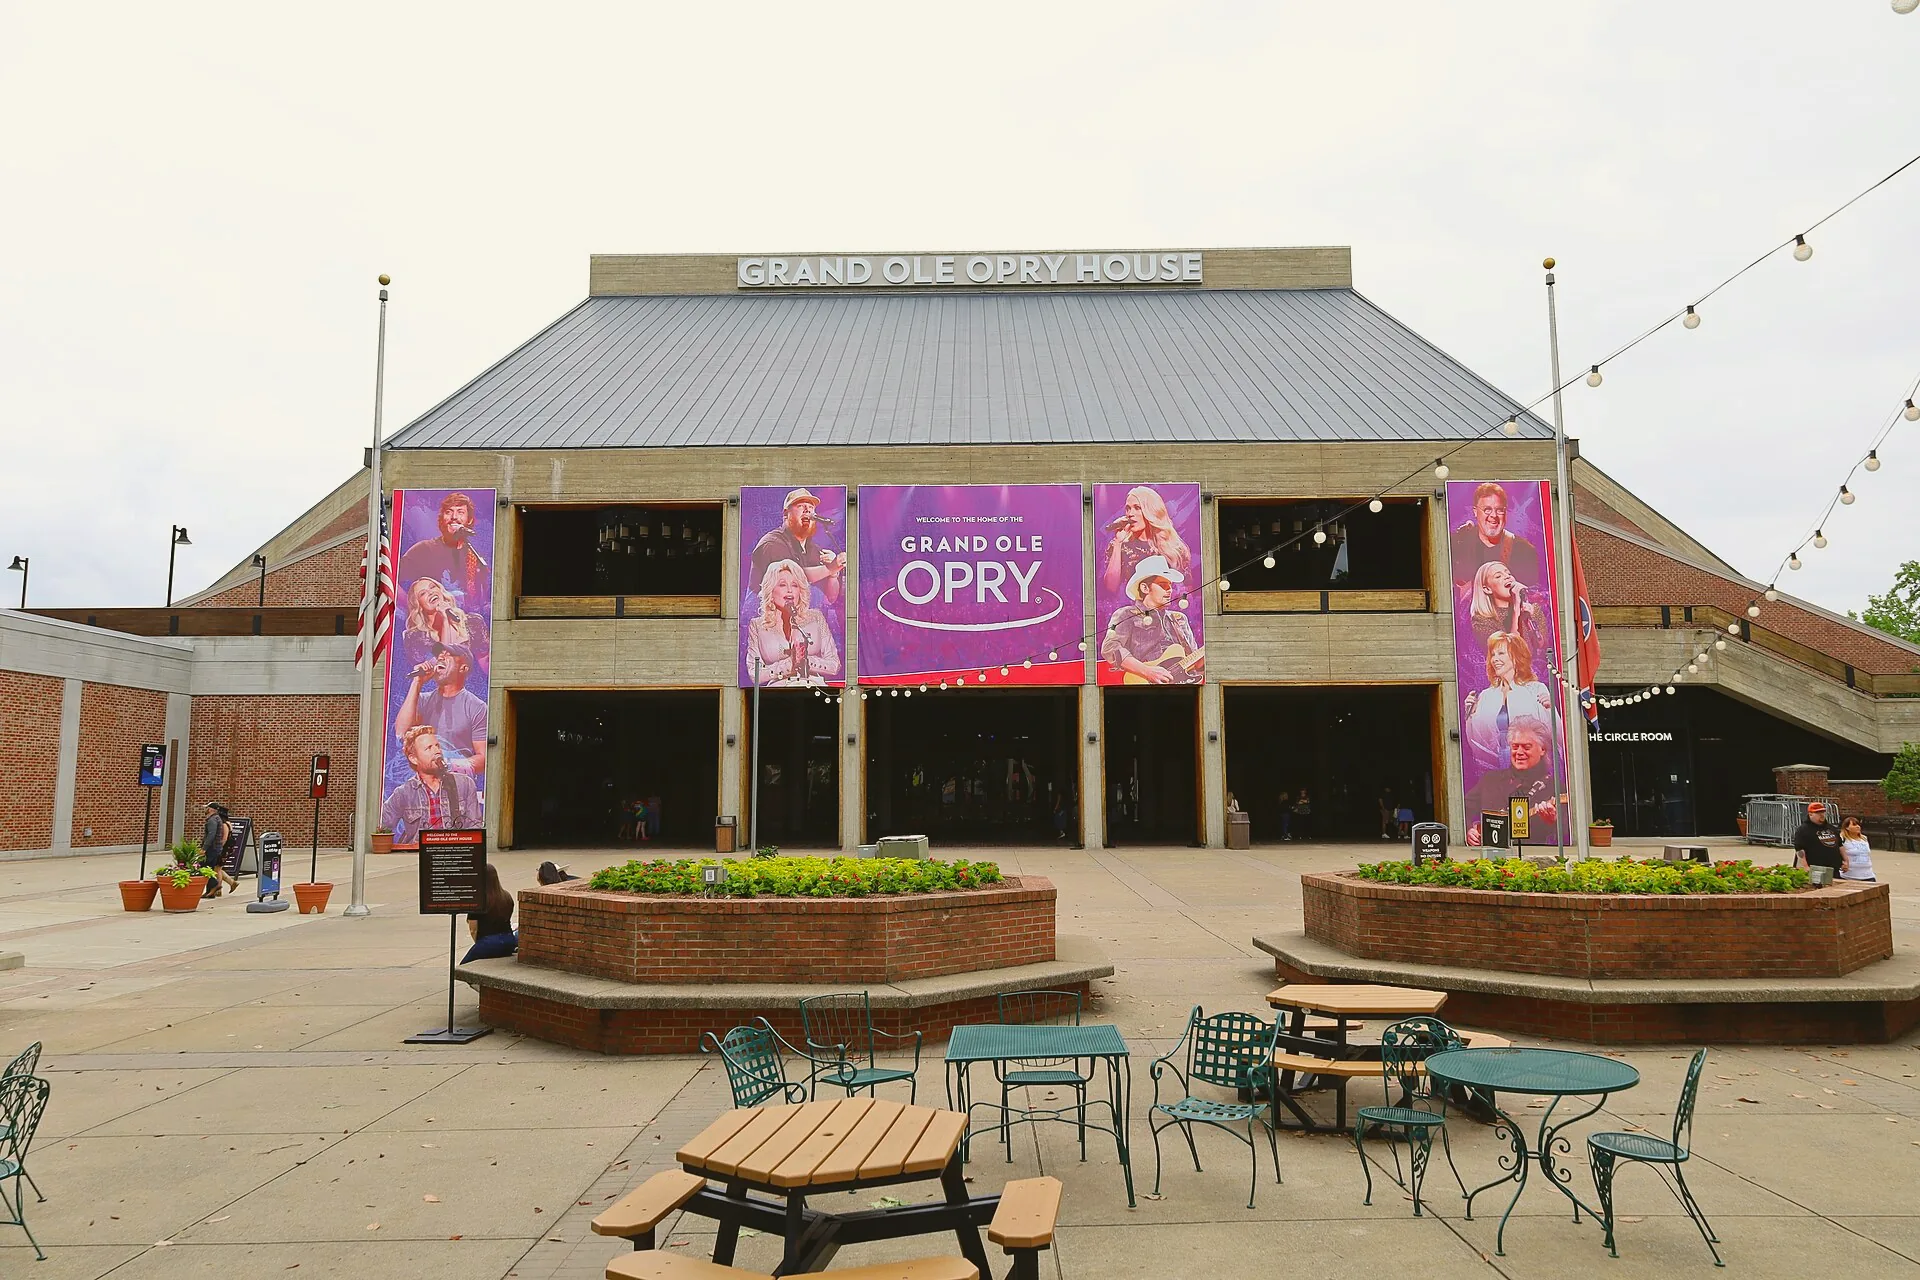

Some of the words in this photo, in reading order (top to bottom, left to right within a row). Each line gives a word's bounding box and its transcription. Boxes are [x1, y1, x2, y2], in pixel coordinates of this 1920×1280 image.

[739, 256, 873, 286] GRAND
[882, 256, 955, 284] OLE
[966, 254, 1067, 283] OPRY
[1076, 253, 1202, 282] HOUSE
[901, 535, 988, 553] GRAND
[995, 535, 1043, 552] OLE
[897, 559, 1043, 605] OPRY
[1588, 732, 1603, 741] HE
[1604, 732, 1640, 741] CIRCLE
[1641, 732, 1673, 741] ROOM
